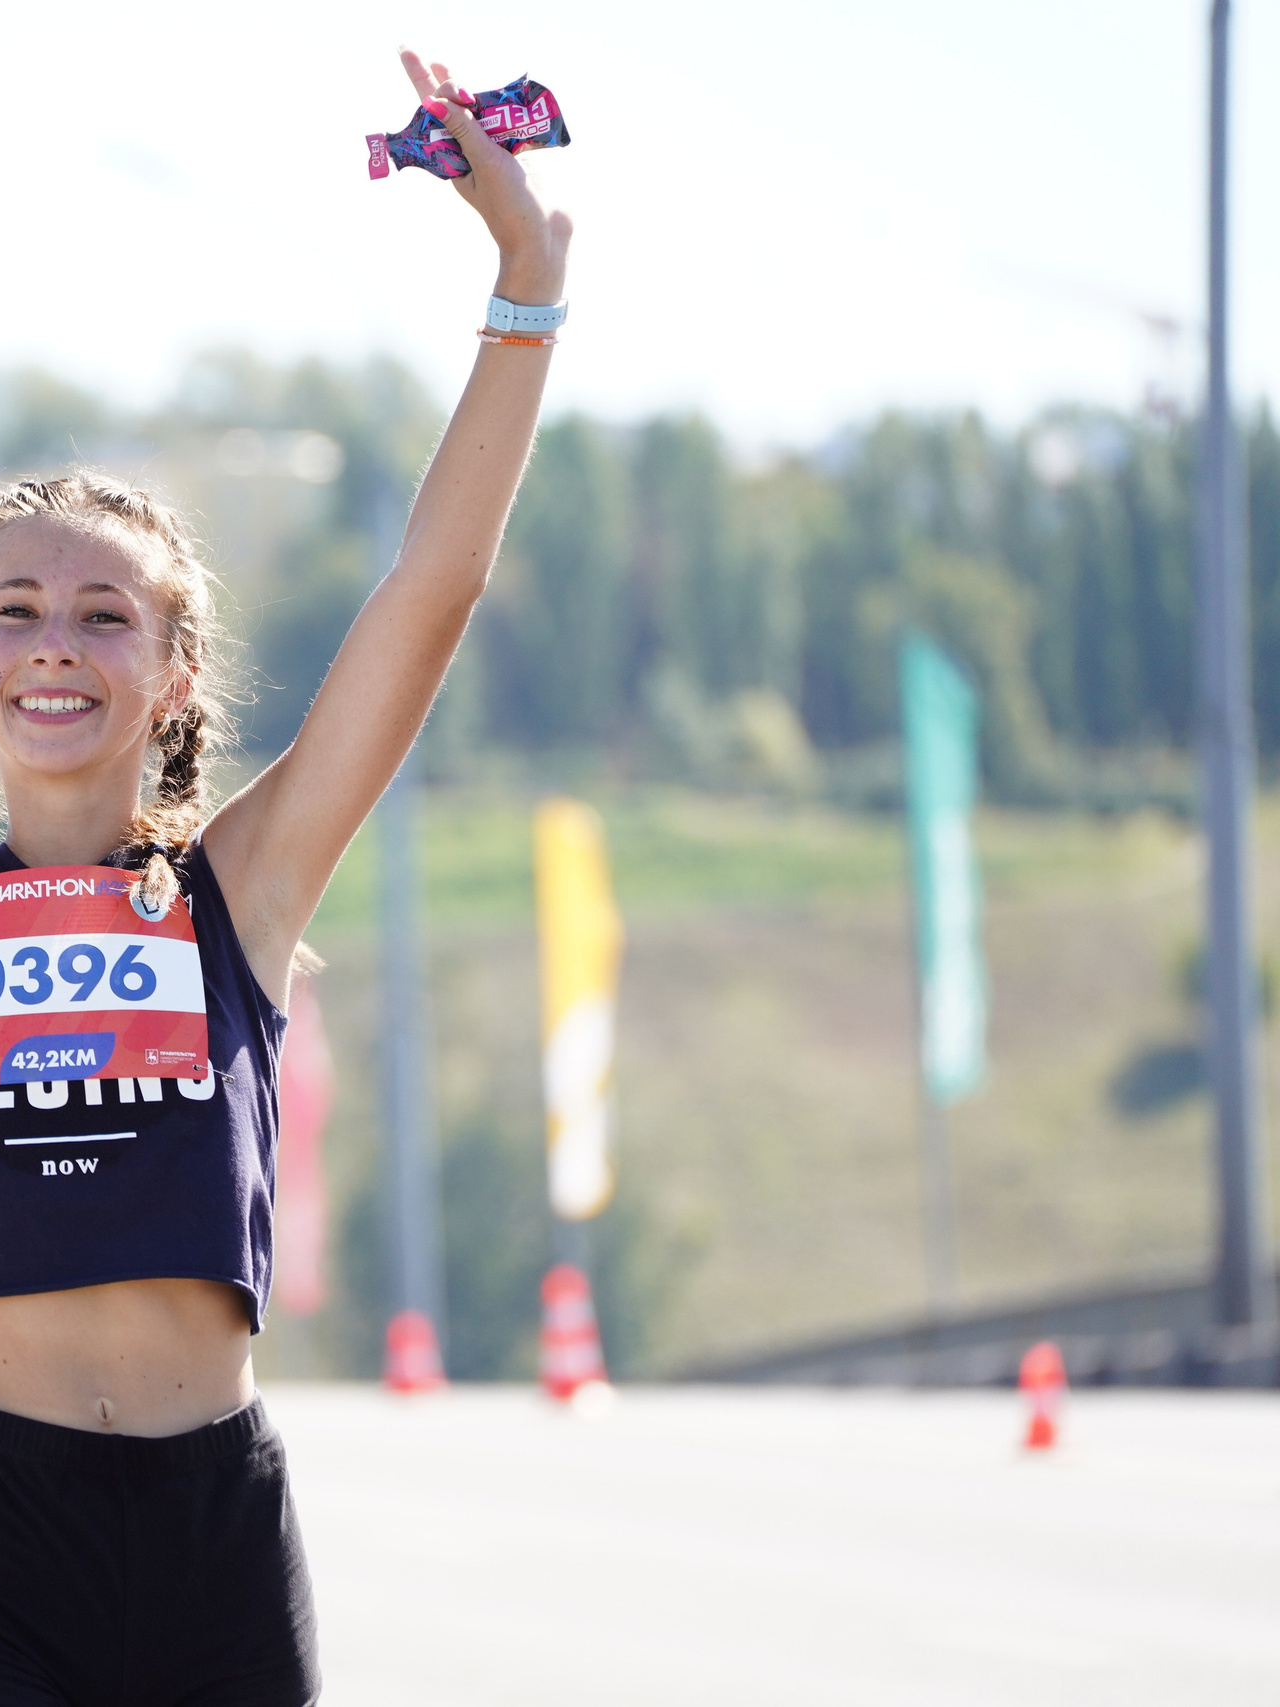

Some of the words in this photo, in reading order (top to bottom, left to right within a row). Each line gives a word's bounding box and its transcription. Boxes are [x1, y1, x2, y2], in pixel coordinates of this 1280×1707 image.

[478, 117, 499, 128] STRAW
[495, 96, 549, 129] GEL
[488, 121, 549, 142] POWERU
[370, 139, 381, 168] OPEN
[41, 1157, 99, 1176] now
